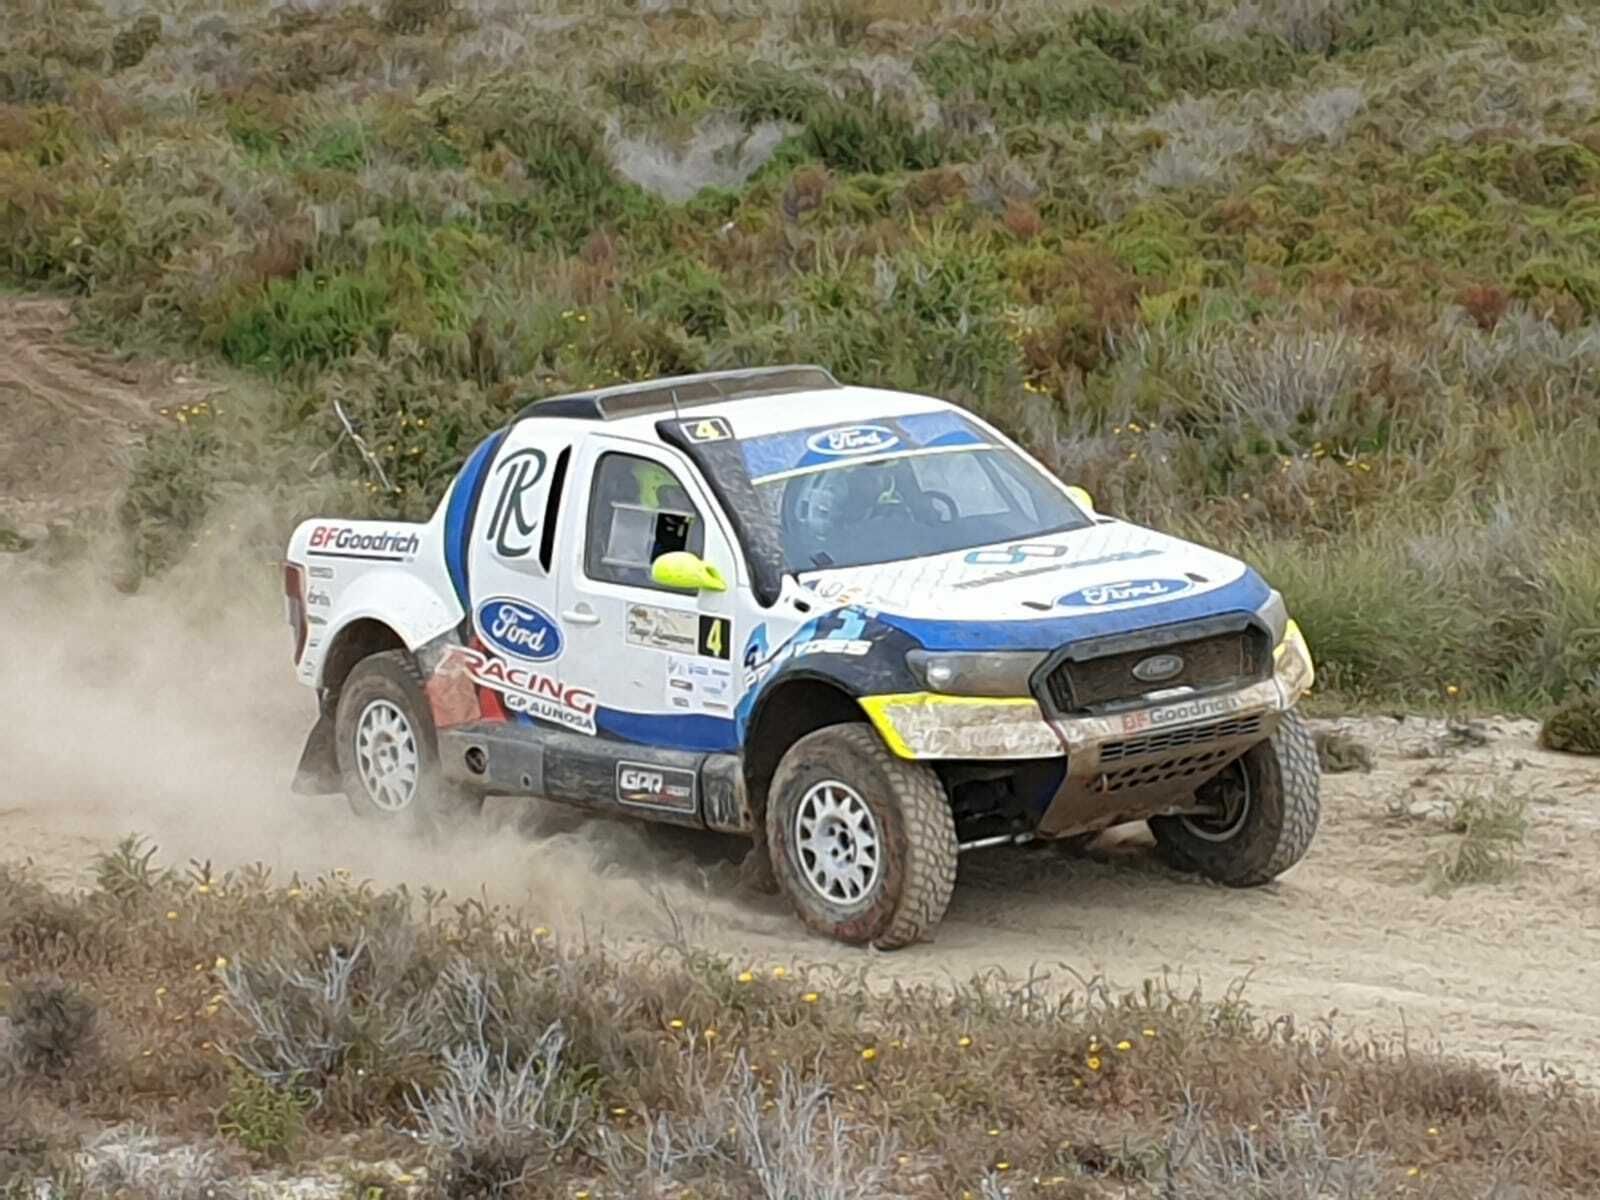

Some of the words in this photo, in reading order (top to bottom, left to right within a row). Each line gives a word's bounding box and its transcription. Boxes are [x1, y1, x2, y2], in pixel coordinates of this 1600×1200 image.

[696, 420, 720, 440] 4
[827, 430, 881, 450] Ford
[308, 526, 420, 554] BFGoodrich
[1081, 581, 1169, 605] Ford
[491, 604, 548, 652] Ford
[706, 619, 722, 657] 4
[455, 650, 596, 715] RACING
[1122, 696, 1237, 732] BFGoodrich
